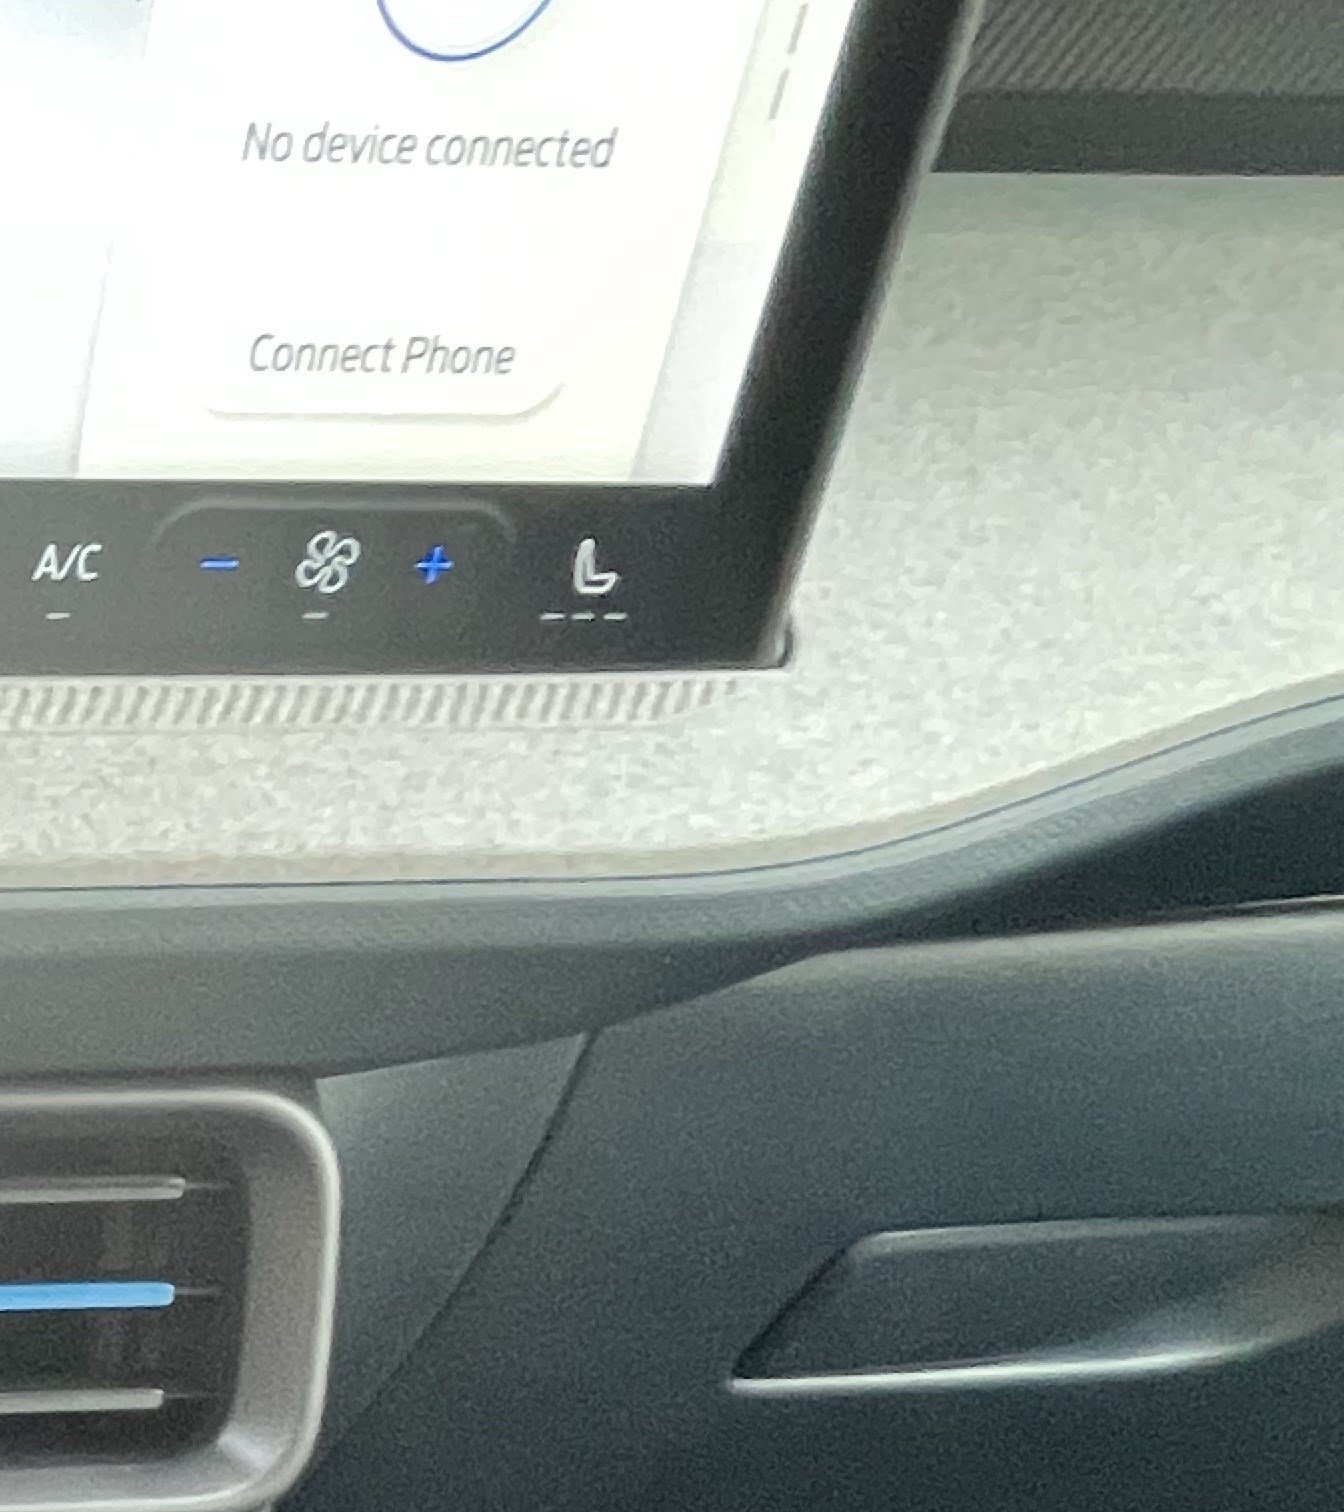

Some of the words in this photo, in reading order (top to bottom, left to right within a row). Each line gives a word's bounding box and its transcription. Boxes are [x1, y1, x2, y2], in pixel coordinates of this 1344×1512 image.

[241, 122, 294, 163] No
[302, 120, 418, 165] device
[424, 126, 620, 169] connected
[249, 332, 396, 374] Connect
[400, 334, 517, 376] Phone
[31, 542, 103, 582] A/C
